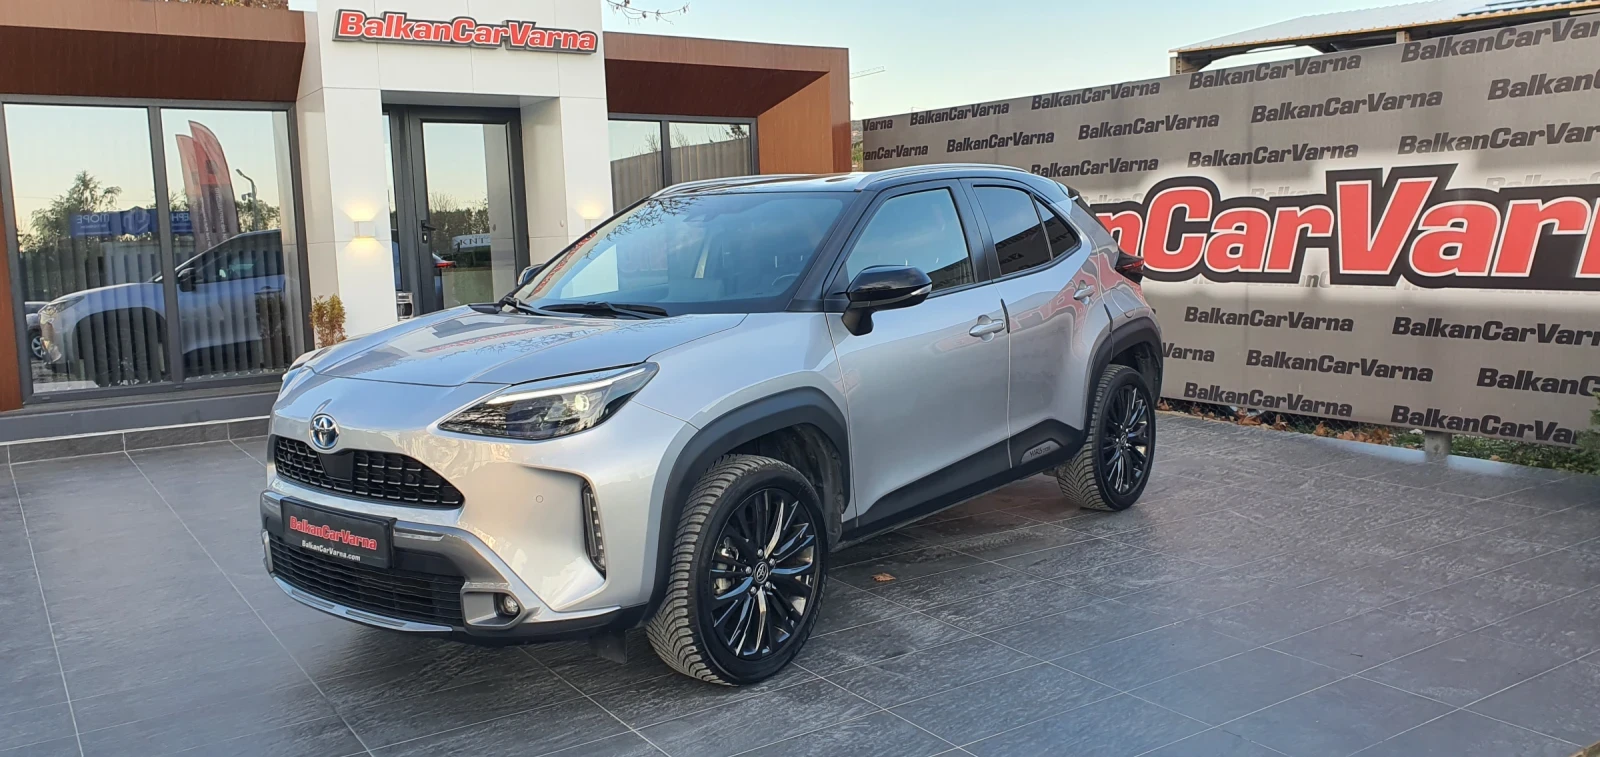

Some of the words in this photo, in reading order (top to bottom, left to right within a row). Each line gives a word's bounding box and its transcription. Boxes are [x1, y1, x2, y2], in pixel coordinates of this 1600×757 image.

[338, 10, 597, 51] BalkanCarVarna
[1189, 55, 1361, 89] BalkanCarVarna
[1031, 82, 1160, 110] BalkanCarVarna
[1251, 91, 1443, 124] BalkanCarVarna
[910, 103, 1009, 126] BalkanCarVarna
[1078, 114, 1219, 140] BalkanCarVarna
[947, 132, 1054, 153] BalkanCarVarna
[1187, 143, 1359, 168] BalkanCarVarna
[1031, 158, 1159, 177] BalkanCarVarna
[1096, 176, 1600, 278] nCarVar
[1184, 306, 1354, 332] BalkanCarVarna
[1162, 342, 1215, 362] Varna
[1246, 349, 1433, 382] BalkanCarVarna
[1184, 382, 1353, 418] BalkanCarVarna
[290, 516, 377, 551] BalkanCarVarna
[301, 540, 361, 561] BalkanCarVarna.com
